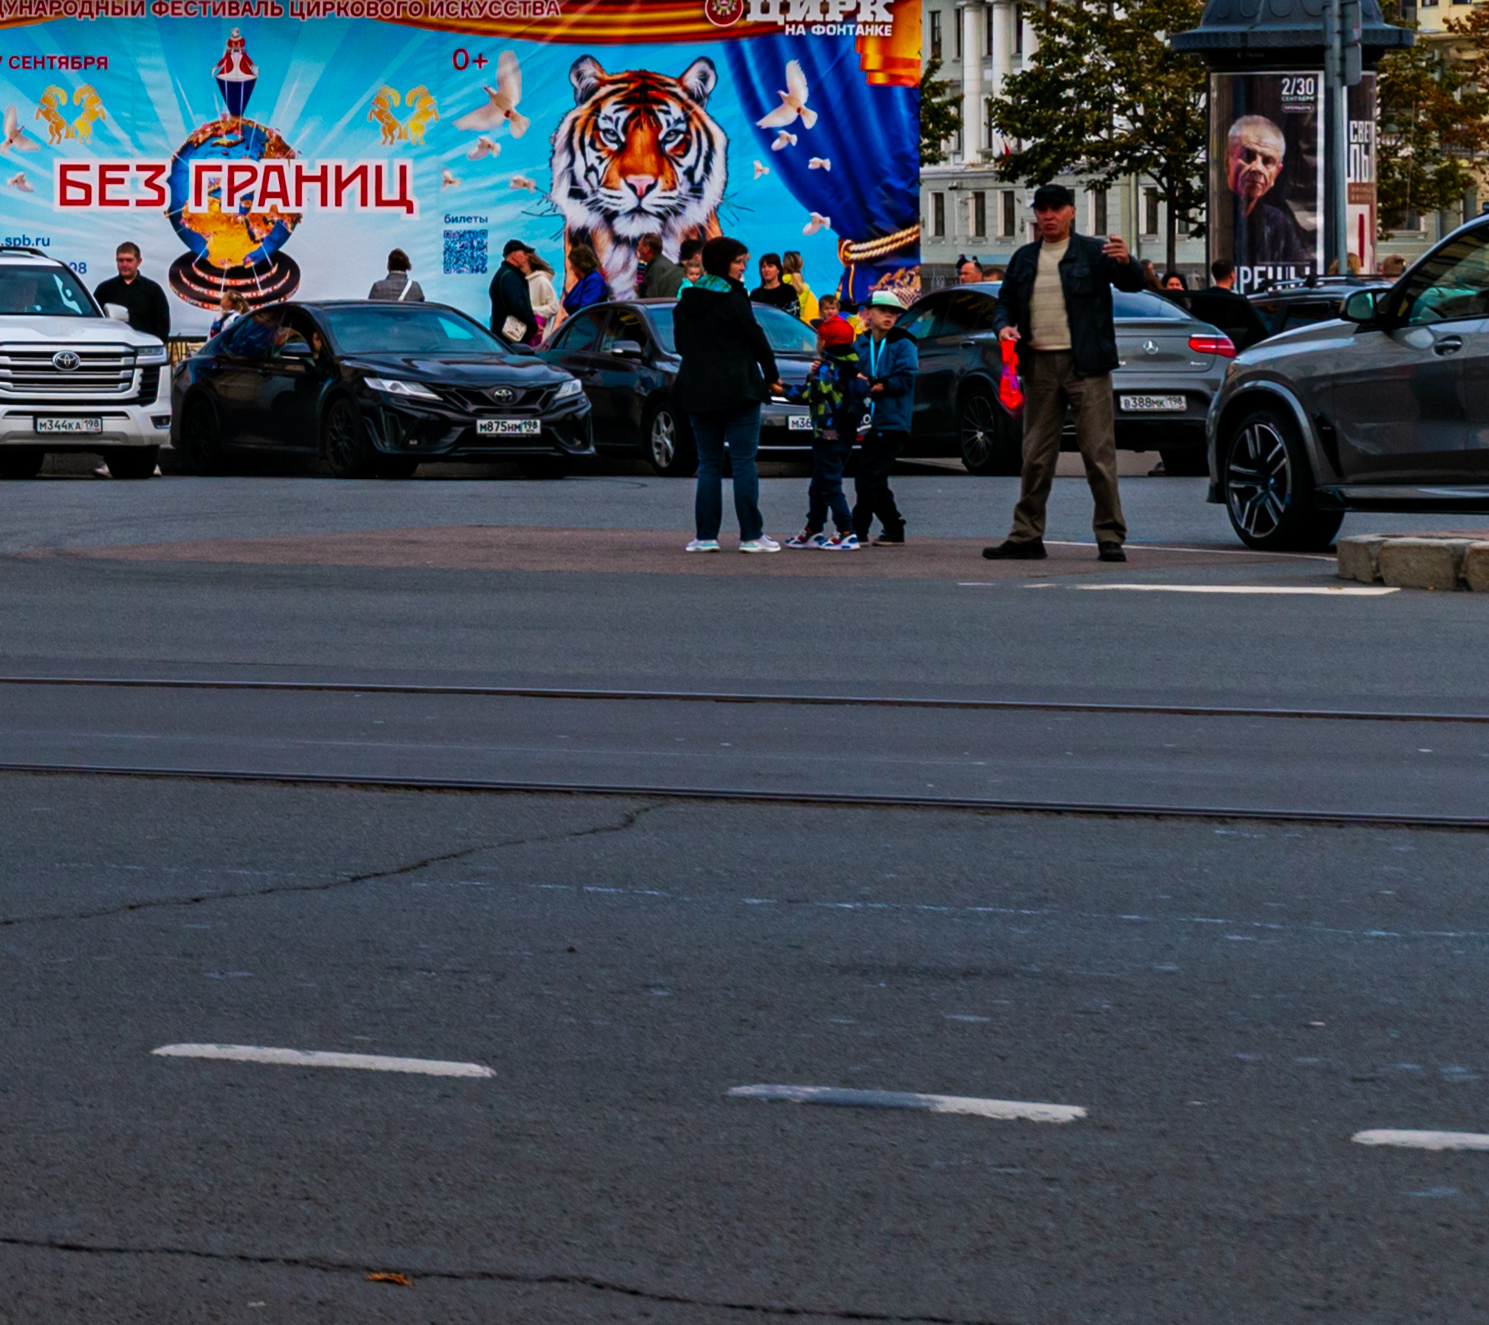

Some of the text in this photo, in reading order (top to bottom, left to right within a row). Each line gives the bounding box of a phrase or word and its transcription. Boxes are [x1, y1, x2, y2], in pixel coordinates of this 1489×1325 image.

[289, 0, 425, 21] ЦИРКОВОГО
[785, 23, 893, 38] НА ФОНТАНКЕ
[8, 54, 109, 71] СЕНТЯБРЯ
[451, 48, 489, 72] 0+
[1281, 77, 1315, 95] 2/30
[60, 163, 415, 215] БЕЗ ГРАНИЦ
[443, 212, 489, 226] билеты
[791, 416, 812, 428] М36
